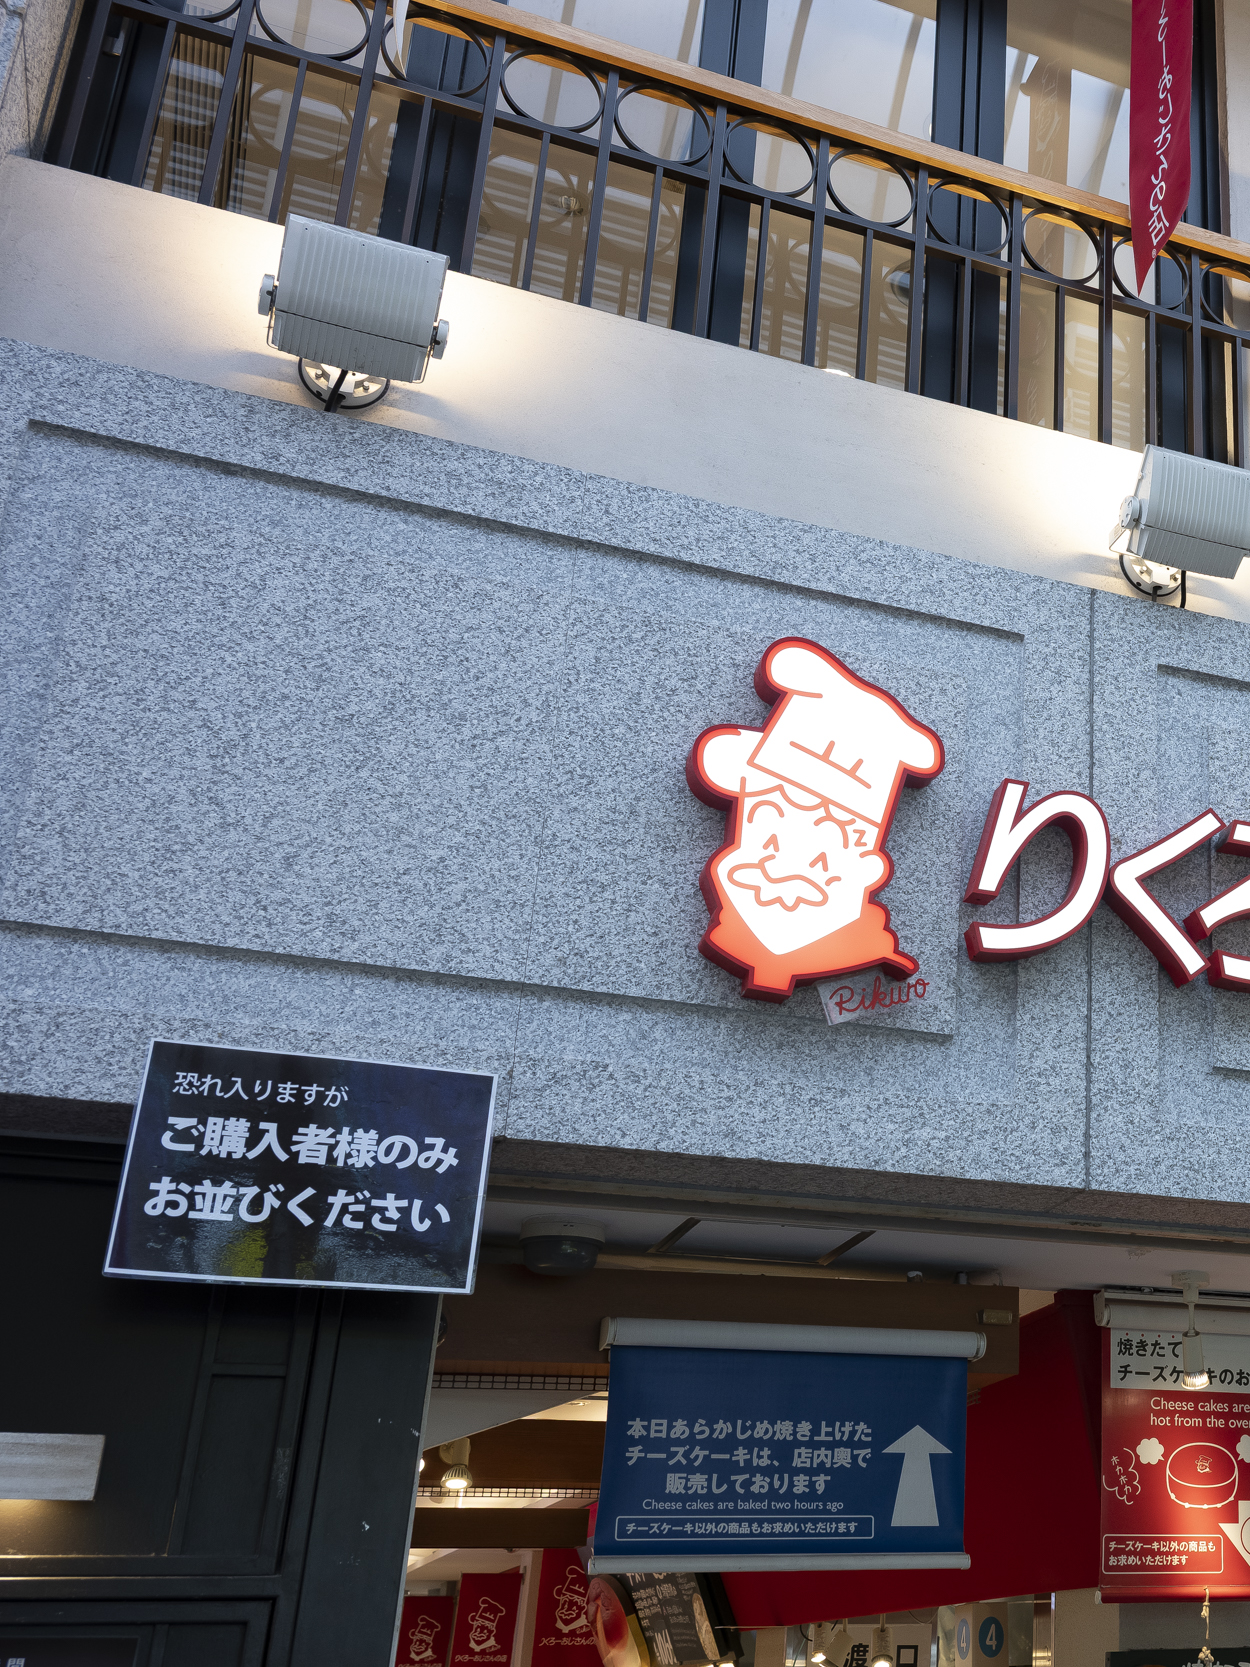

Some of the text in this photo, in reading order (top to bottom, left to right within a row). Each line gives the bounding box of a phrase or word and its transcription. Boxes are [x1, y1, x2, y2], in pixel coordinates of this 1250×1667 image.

[829, 975, 930, 1016] Rikuro
[172, 1070, 349, 1108] 恐れ入りますが
[160, 1115, 460, 1174] ご購入者様のみ
[143, 1175, 451, 1232] お並びください
[1116, 1337, 1183, 1358] 焼きたて
[1150, 1397, 1250, 1413] Cheese cakes are
[626, 1417, 873, 1441] 本日あらかじめ焼き上げた
[1150, 1413, 1171, 1426] hot
[1174, 1414, 1203, 1427] from
[1205, 1415, 1226, 1428] the
[665, 1473, 831, 1494] 販売しております
[1110, 1455, 1132, 1495] ホカホカ
[642, 1499, 844, 1512] Cheese cakes are baked two hours ago
[625, 1522, 859, 1535] チーズケーキ以外の商品もお求めいただけます
[1108, 1540, 1216, 1552] チーズケーキ以外の商品も
[1108, 1554, 1189, 1566] お求めいただけます
